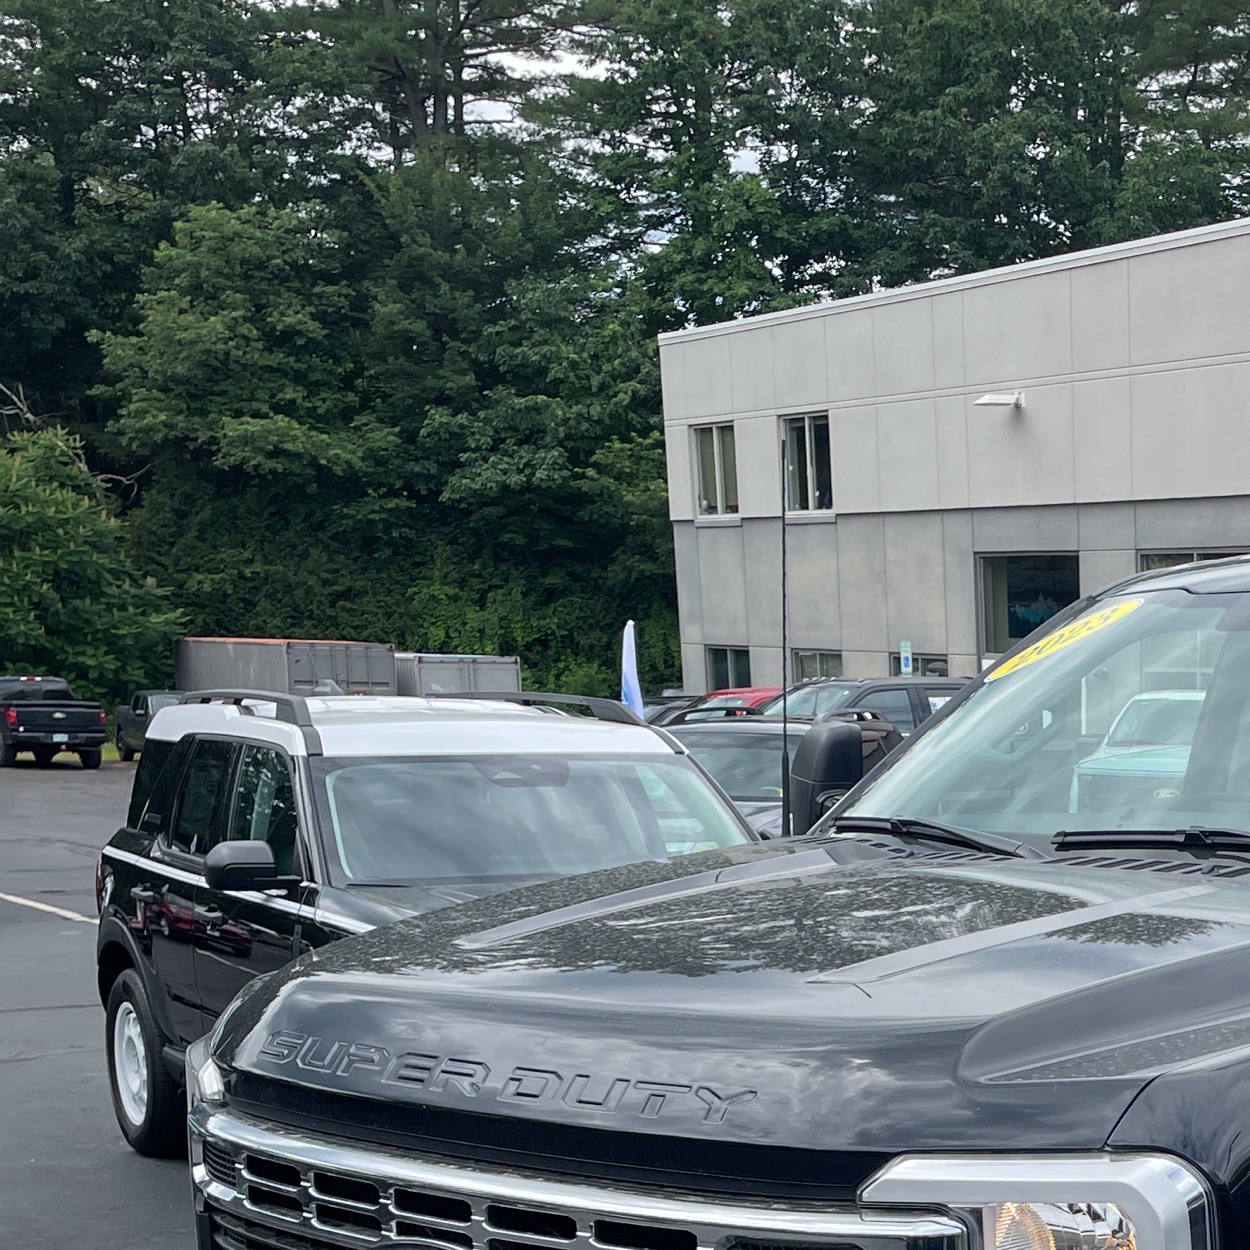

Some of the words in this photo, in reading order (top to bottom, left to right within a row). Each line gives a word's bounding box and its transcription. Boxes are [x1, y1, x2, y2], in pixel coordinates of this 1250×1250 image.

[1010, 607, 1119, 670] 2023
[256, 1028, 493, 1098] SUPER
[496, 1066, 759, 1125] DUTY
